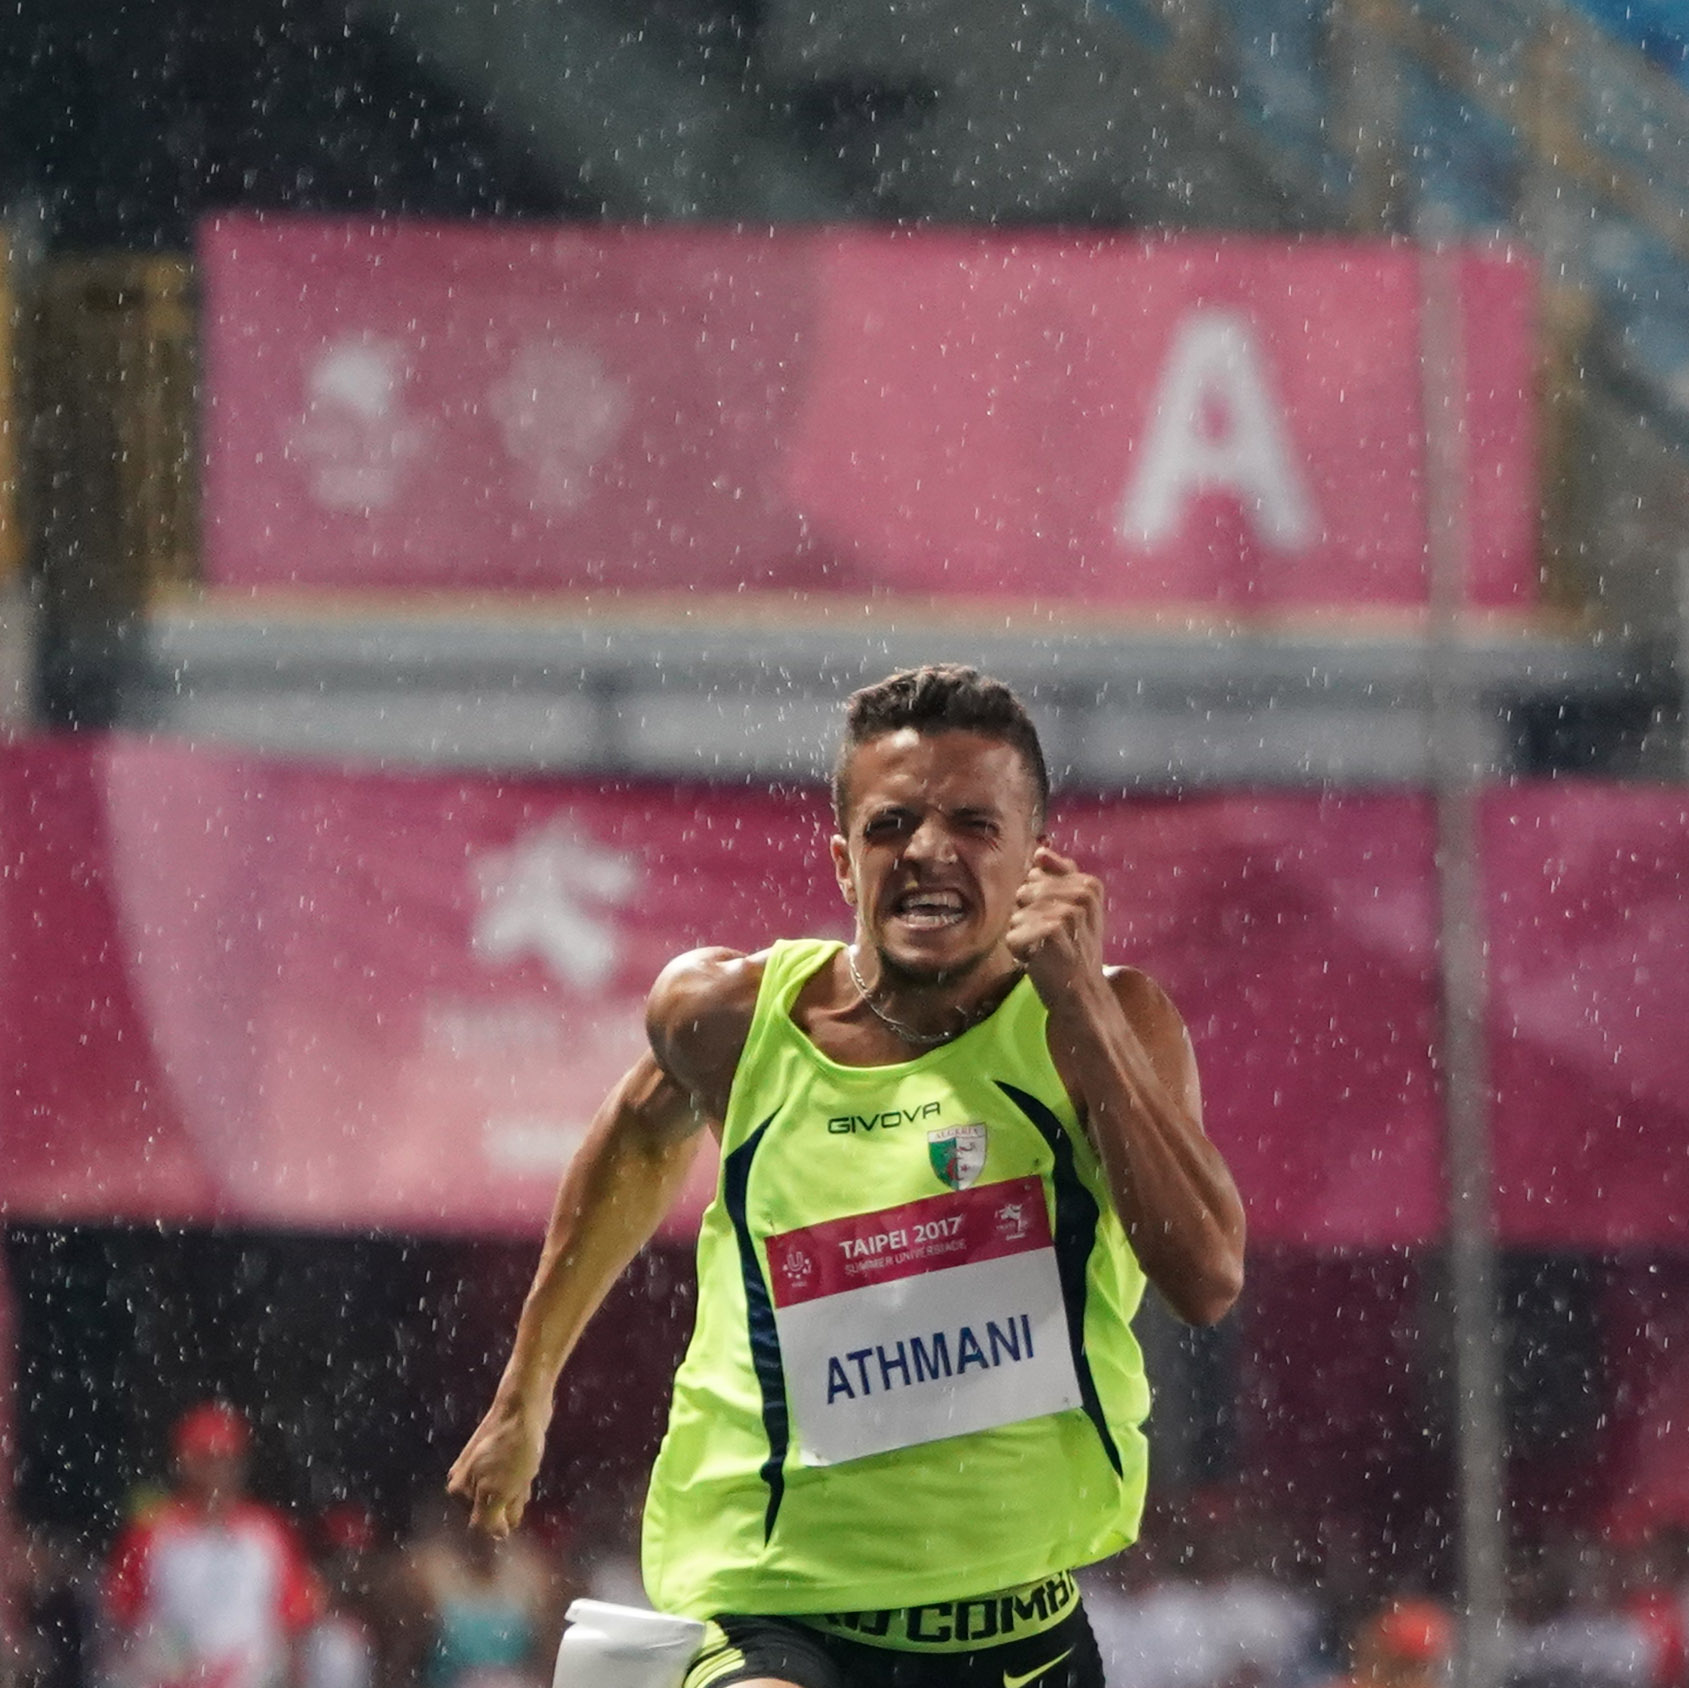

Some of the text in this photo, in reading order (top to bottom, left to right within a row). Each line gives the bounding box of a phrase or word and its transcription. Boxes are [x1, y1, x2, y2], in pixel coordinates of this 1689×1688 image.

[1118, 308, 1325, 552] A
[828, 1101, 940, 1134] GIVOVA
[935, 1127, 978, 1139] ALGERIA
[839, 1229, 908, 1259] TAIPEI
[912, 1215, 963, 1244] 2017
[844, 1255, 894, 1276] SUMMER
[827, 1314, 1034, 1405] ATHMANI
[906, 1570, 1074, 1643] COMB
